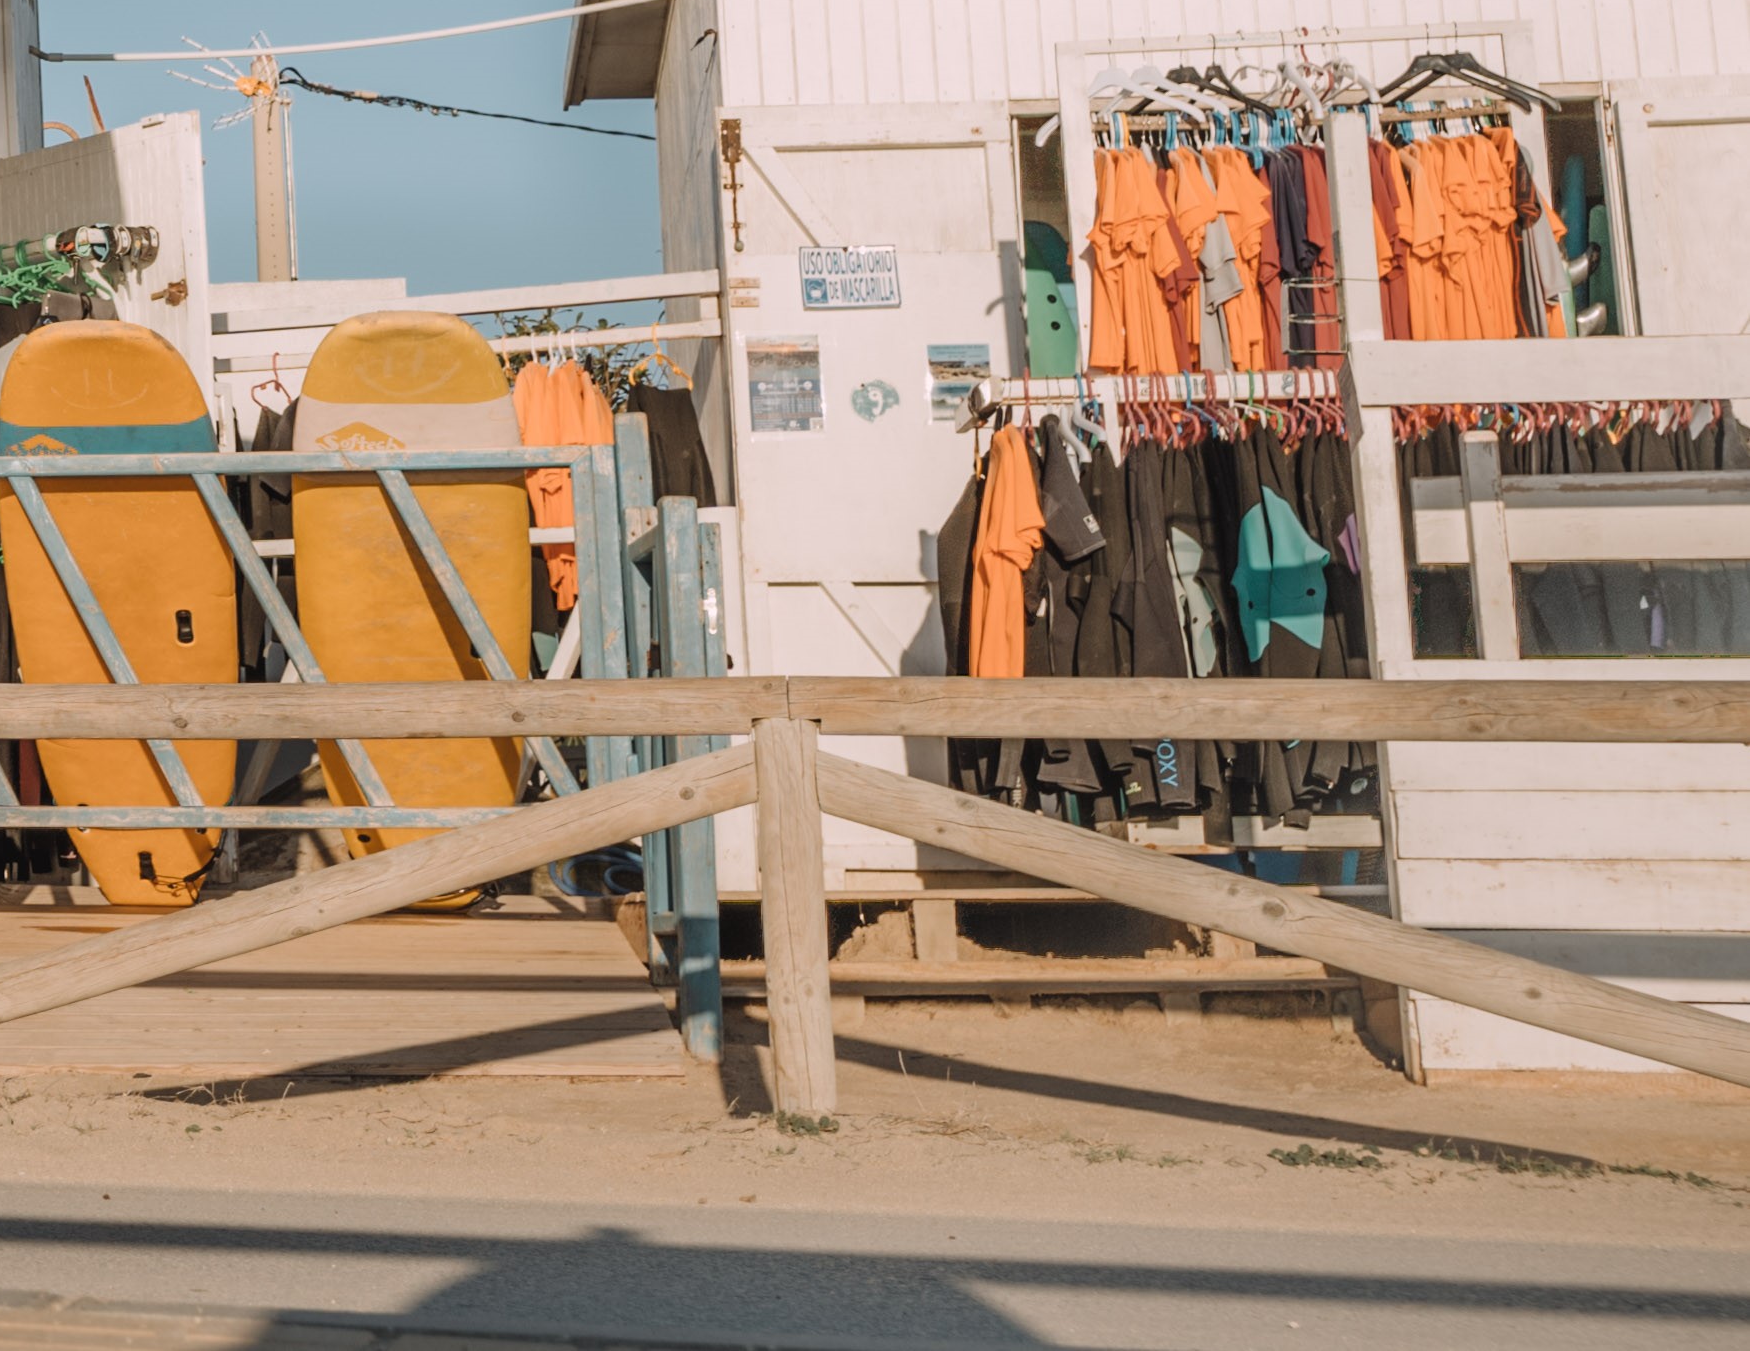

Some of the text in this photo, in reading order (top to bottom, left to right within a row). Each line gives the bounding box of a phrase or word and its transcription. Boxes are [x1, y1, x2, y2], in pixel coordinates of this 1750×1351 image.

[802, 250, 893, 275] USO OBLIGATORIO
[828, 276, 896, 303] DE MASCARILLA
[1156, 739, 1178, 787] OXY
